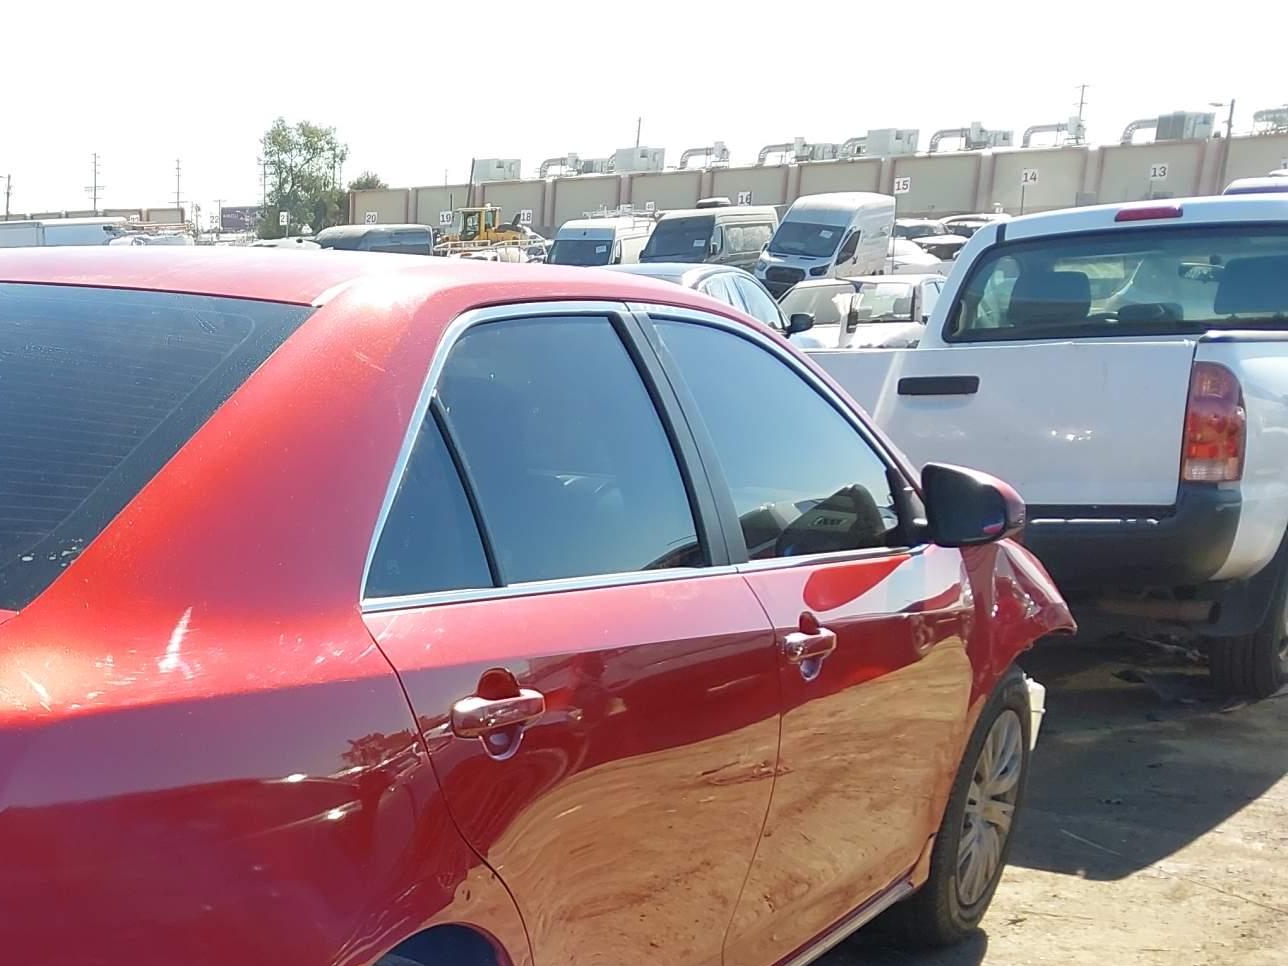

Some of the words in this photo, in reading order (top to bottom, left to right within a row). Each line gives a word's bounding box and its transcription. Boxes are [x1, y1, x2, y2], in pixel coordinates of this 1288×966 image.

[1023, 171, 1037, 183] 14
[1151, 166, 1167, 177] 13
[895, 179, 909, 191] 15
[366, 214, 377, 223] 20
[522, 211, 531, 222] 18
